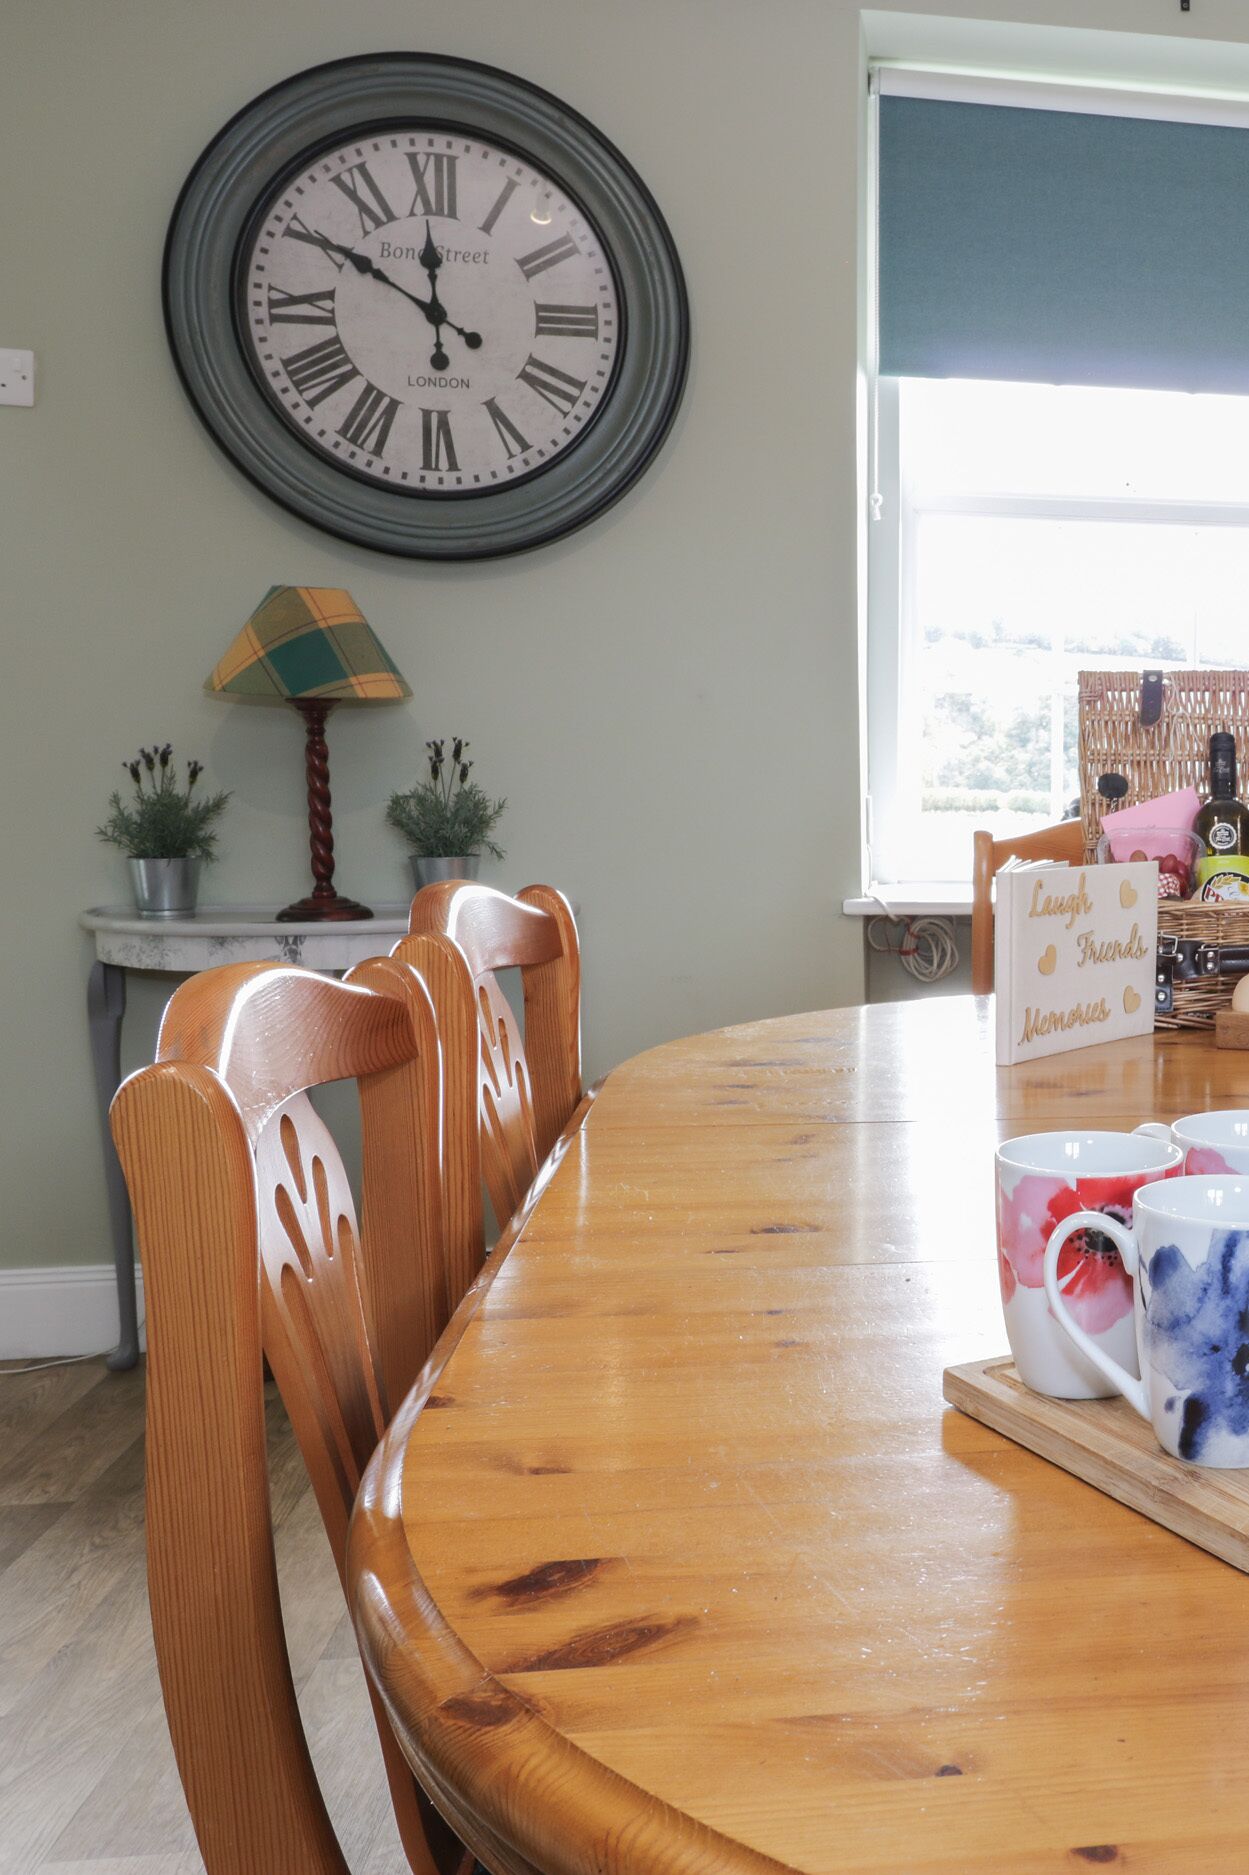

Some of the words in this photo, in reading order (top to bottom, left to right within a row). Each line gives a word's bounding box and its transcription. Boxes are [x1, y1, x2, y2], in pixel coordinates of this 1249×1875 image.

[328, 161, 400, 239] XI
[404, 151, 461, 222] XII
[478, 175, 521, 237] I
[282, 211, 355, 273] X
[433, 244, 490, 265] Street
[514, 231, 582, 282] II
[267, 282, 337, 328] IX
[534, 300, 599, 344] III
[279, 334, 364, 411] VIII
[407, 375, 470, 390] LONDON
[515, 352, 588, 419] IV
[334, 380, 404, 459] VII
[418, 407, 462, 472] VI
[480, 396, 534, 460] V
[1029, 872, 1094, 930] Laugh
[1076, 922, 1149, 968] Friends
[1017, 997, 1111, 1047] Memories
